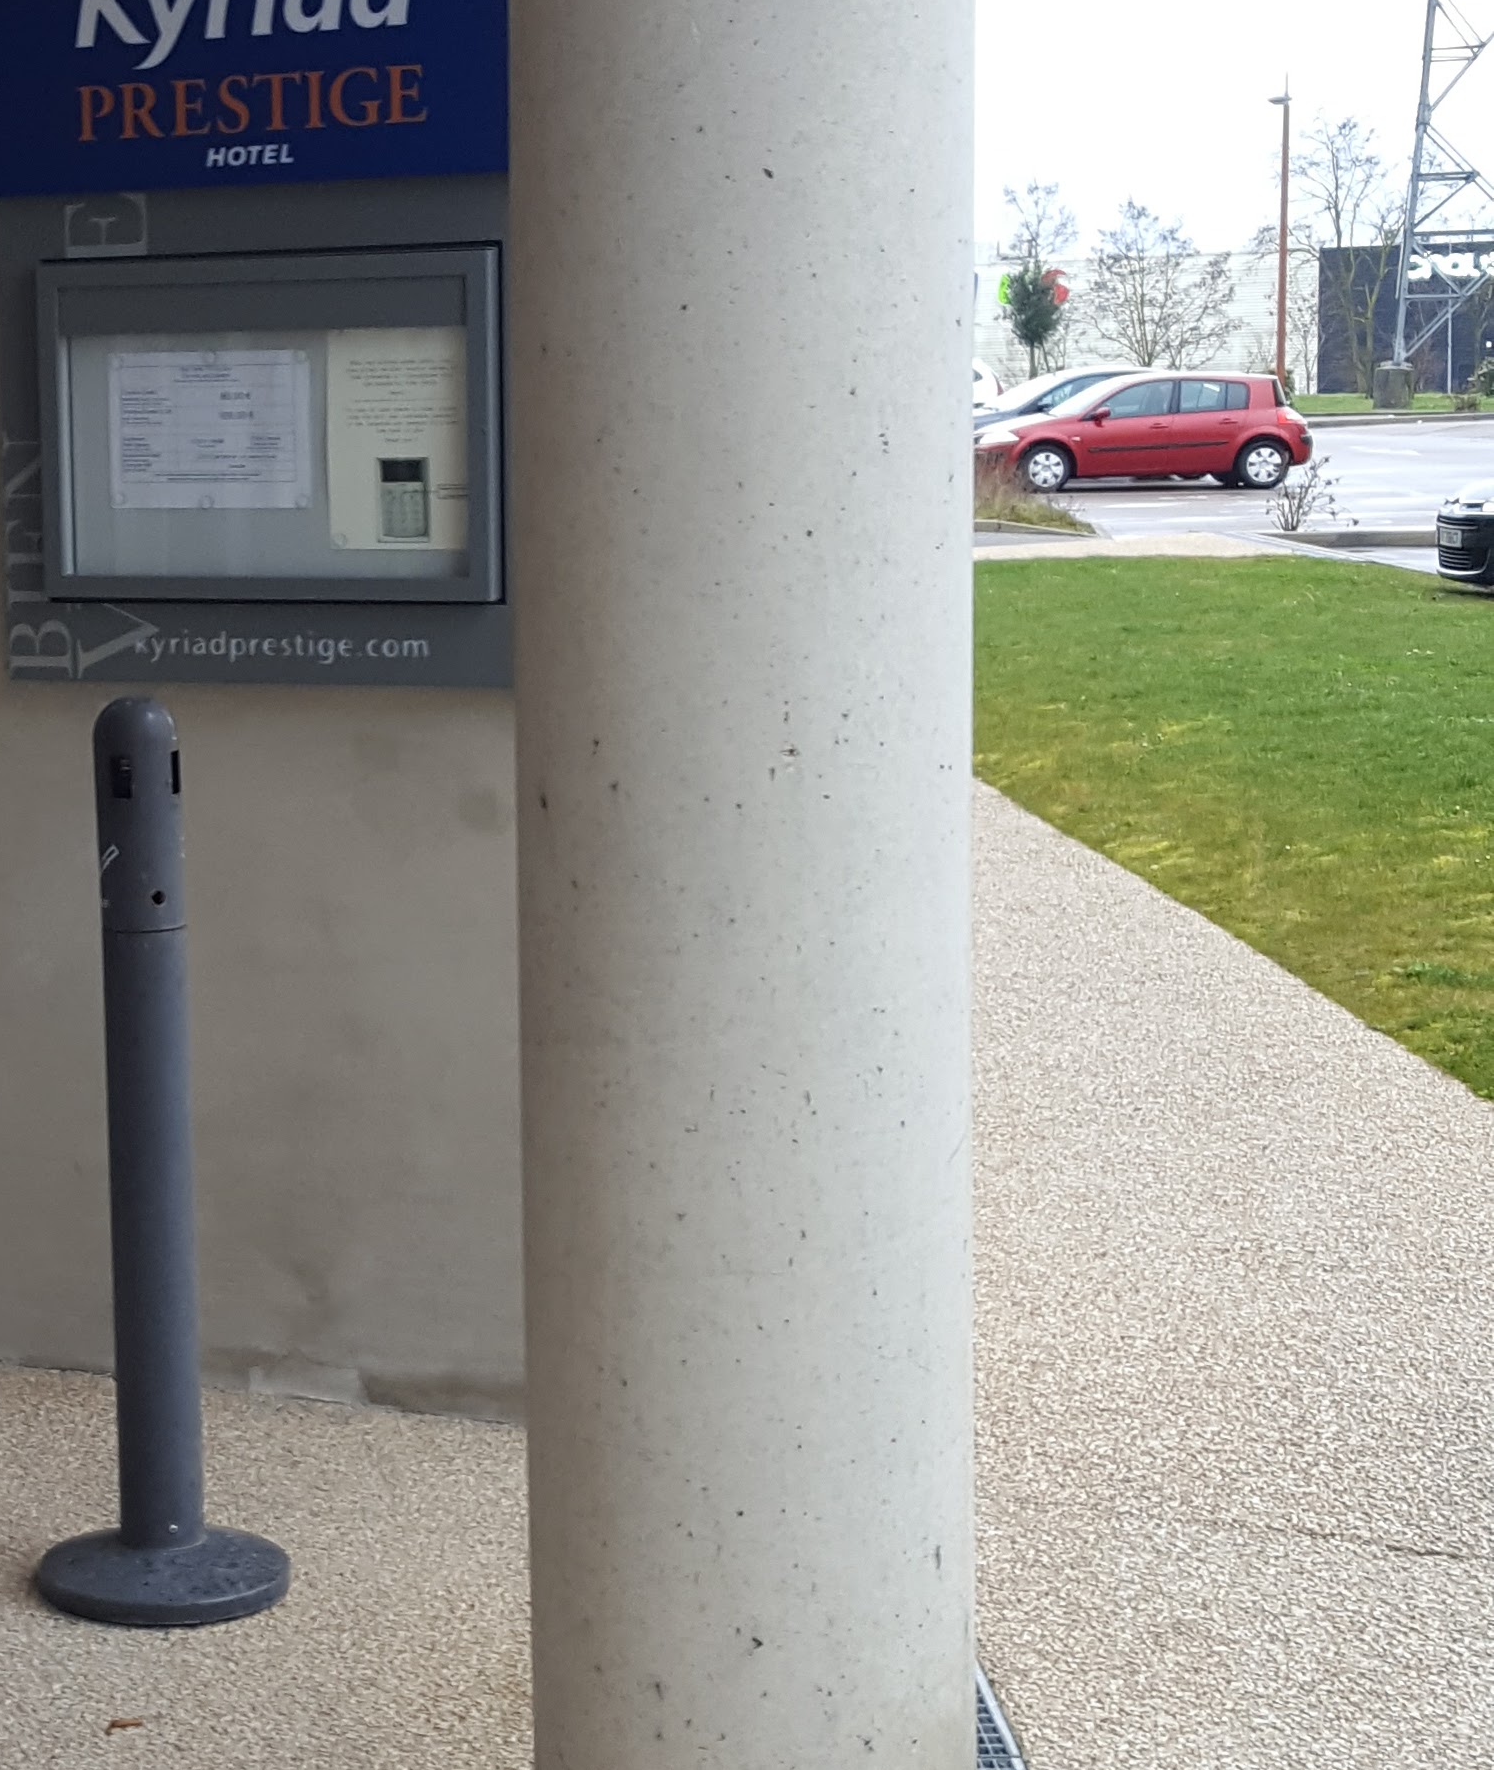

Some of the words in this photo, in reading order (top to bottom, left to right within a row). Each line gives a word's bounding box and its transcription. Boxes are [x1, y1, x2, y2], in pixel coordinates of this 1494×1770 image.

[75, 64, 428, 143] PRESTIGE
[206, 143, 294, 168] HOTEL
[134, 629, 431, 665] kyriadprestige.com
